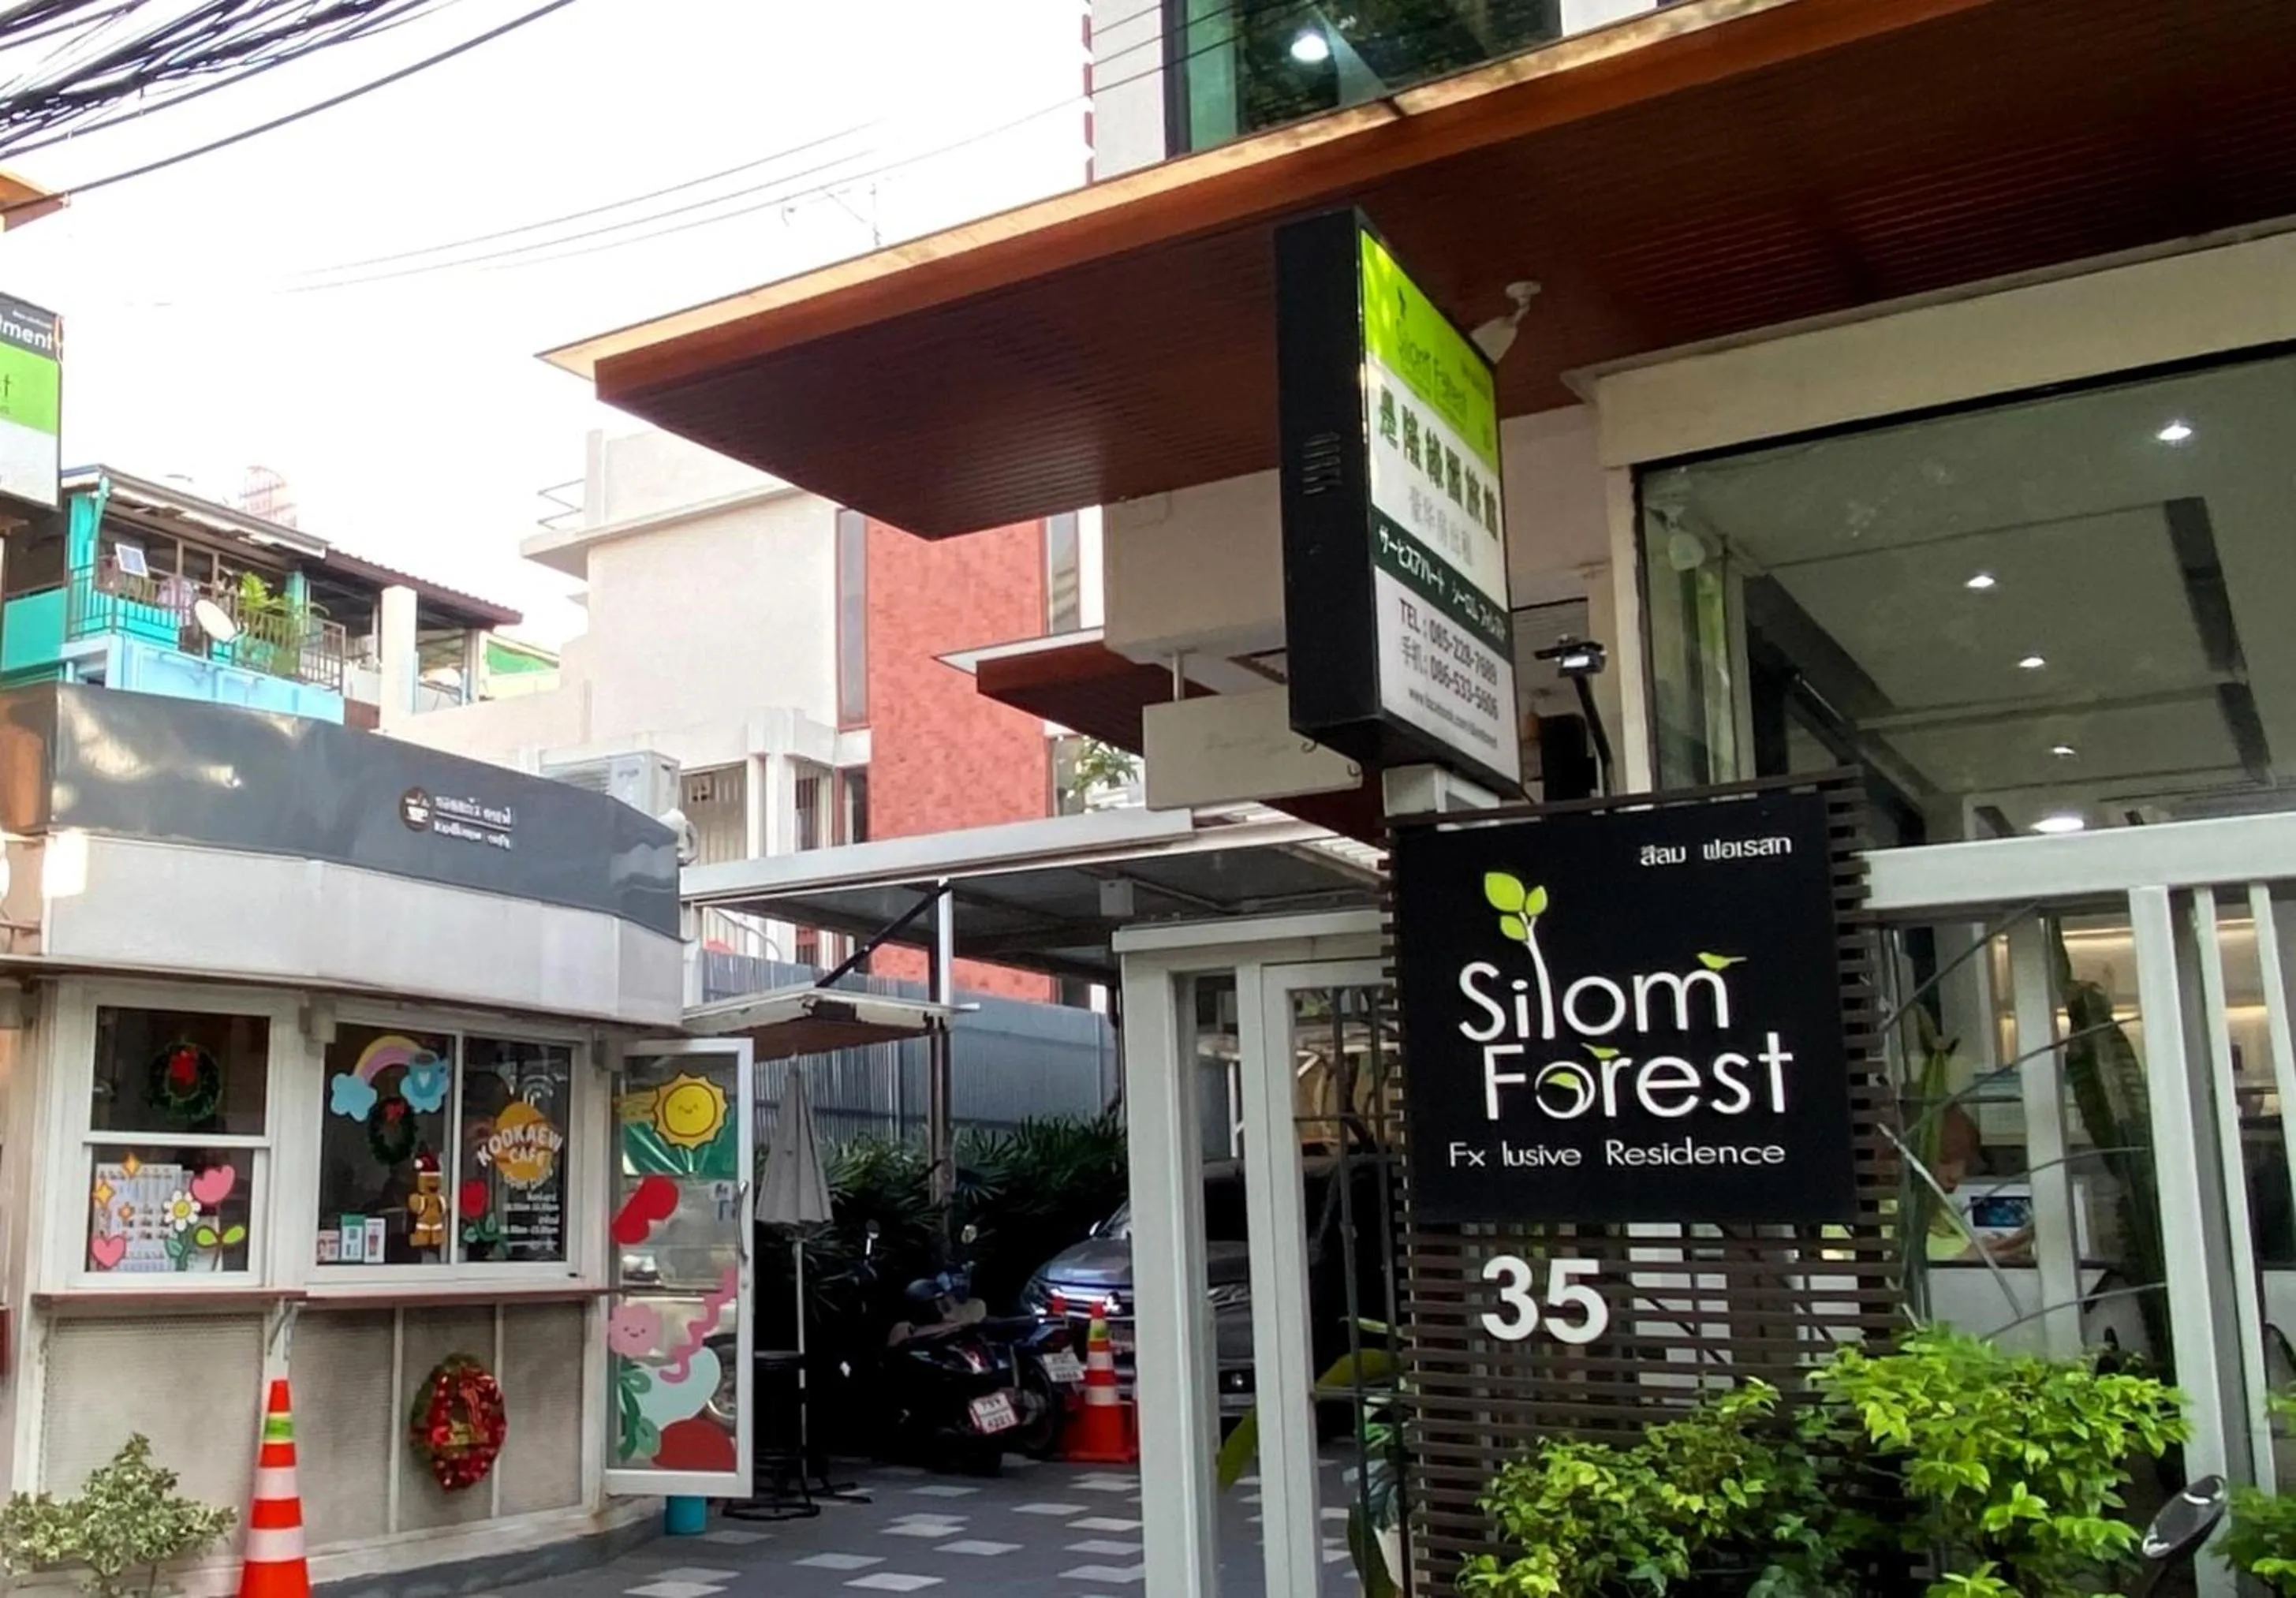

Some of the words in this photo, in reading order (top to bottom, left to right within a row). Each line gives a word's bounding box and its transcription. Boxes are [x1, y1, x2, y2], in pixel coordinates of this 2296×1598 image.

[1459, 913, 1730, 1042] Silom
[1484, 1032, 1793, 1121] Forest
[1606, 1136, 1786, 1167] Residence
[1481, 1254, 1609, 1344] 35
